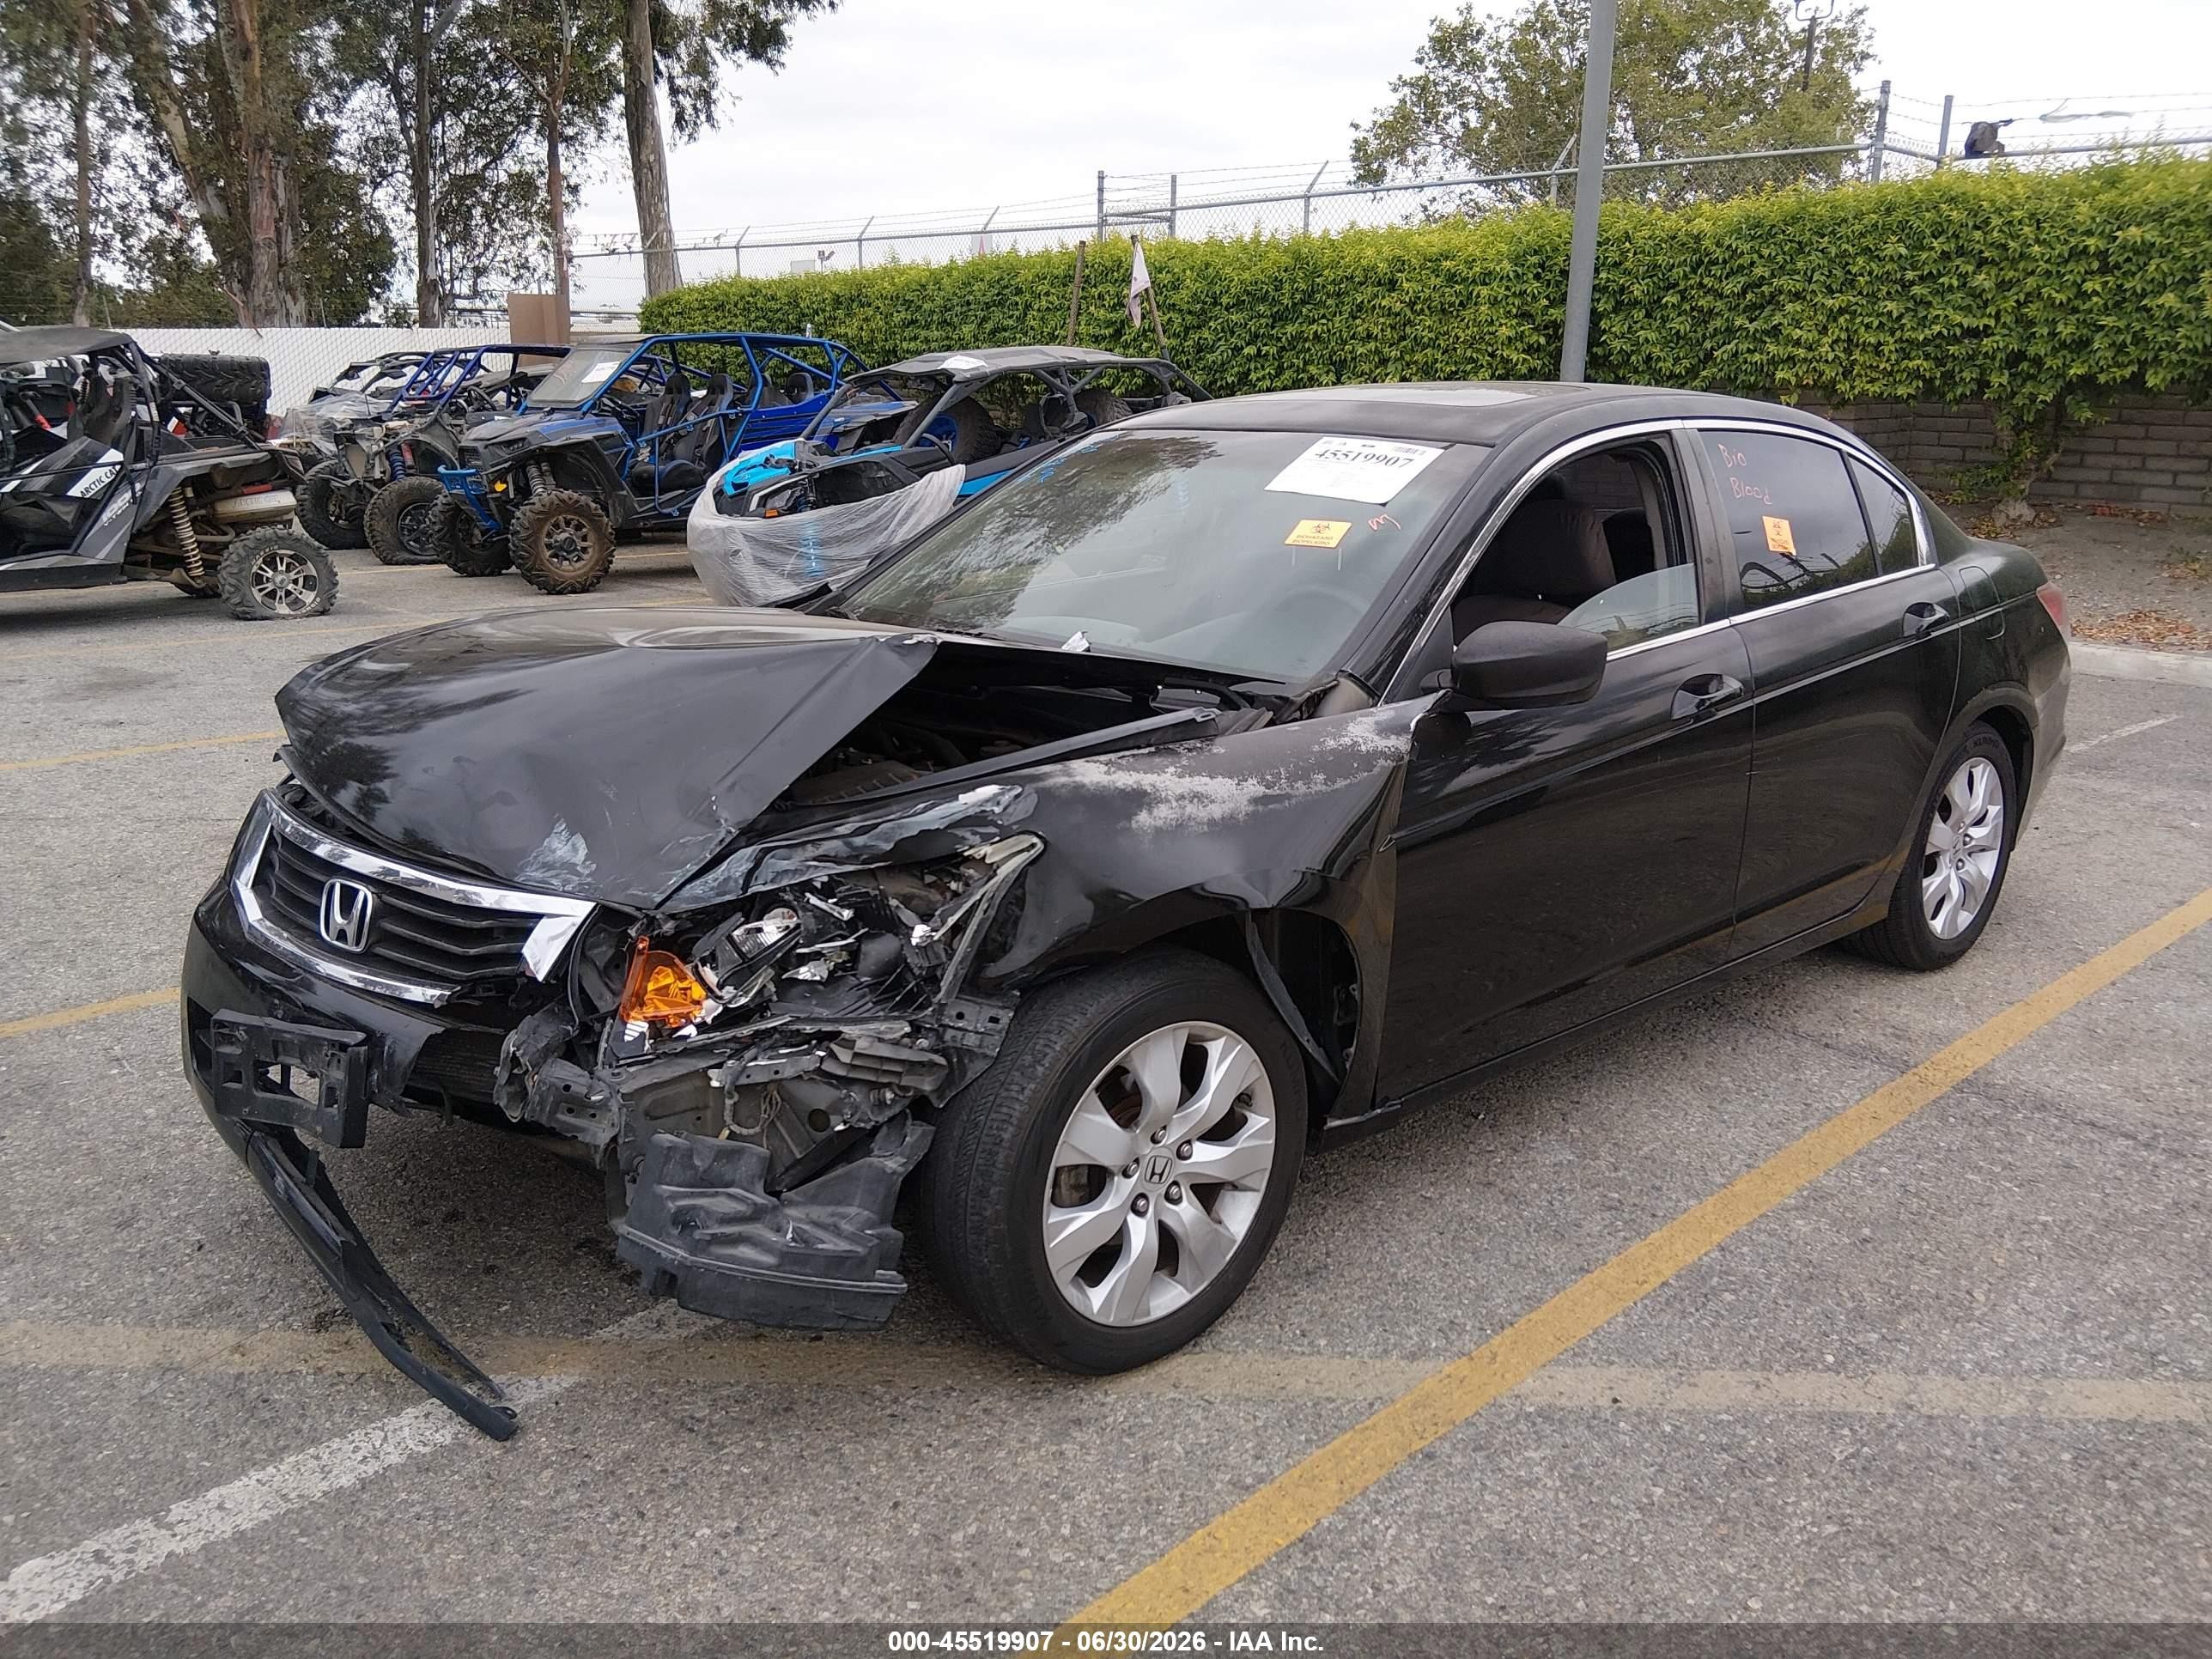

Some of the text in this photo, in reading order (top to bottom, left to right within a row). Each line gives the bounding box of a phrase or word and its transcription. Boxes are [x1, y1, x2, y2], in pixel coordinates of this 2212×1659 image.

[1315, 448, 1415, 468] 45519907
[1717, 443, 1747, 468] Bio
[80, 474, 105, 498] ARCTIC
[1729, 477, 1772, 505] Blood
